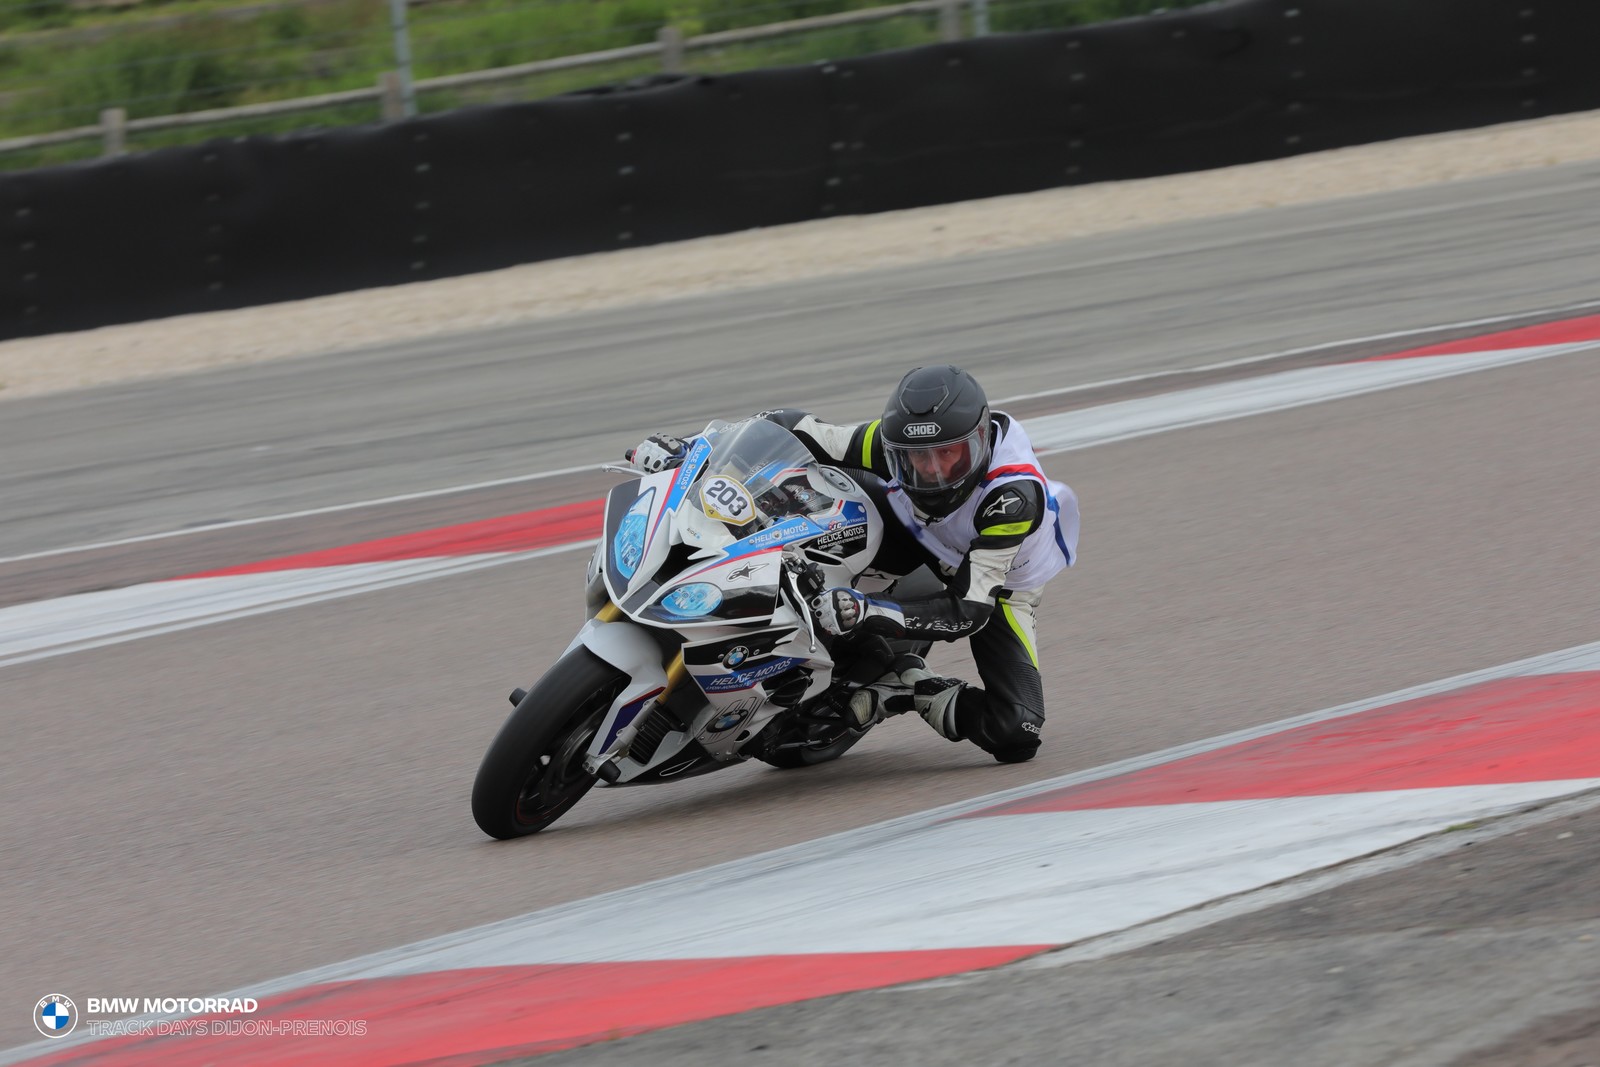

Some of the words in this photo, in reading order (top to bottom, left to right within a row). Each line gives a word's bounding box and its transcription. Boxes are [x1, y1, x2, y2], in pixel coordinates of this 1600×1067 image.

[907, 424, 936, 436] SHOEI
[705, 479, 748, 517] 203
[817, 532, 843, 546] HELICE
[843, 526, 865, 538] MOTOS
[710, 671, 755, 686] HELICE
[754, 657, 793, 678] MOTOS
